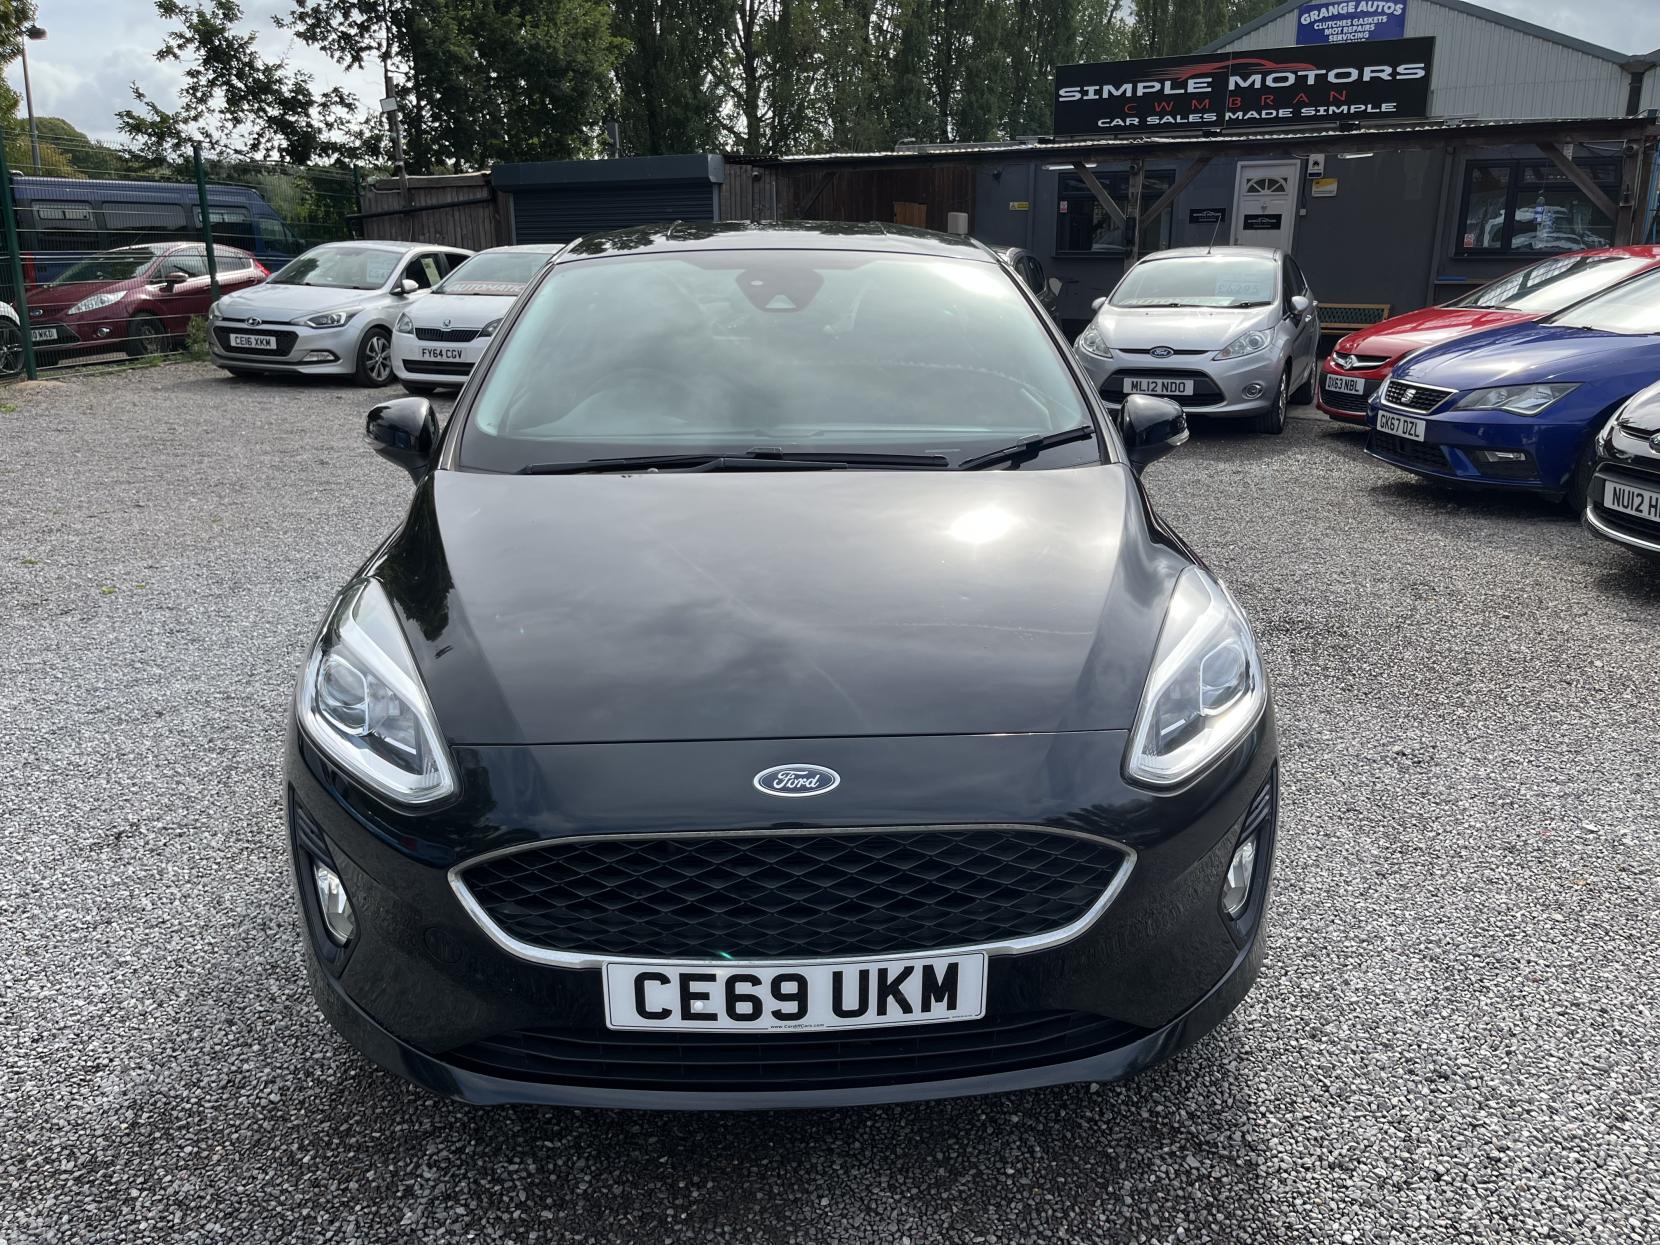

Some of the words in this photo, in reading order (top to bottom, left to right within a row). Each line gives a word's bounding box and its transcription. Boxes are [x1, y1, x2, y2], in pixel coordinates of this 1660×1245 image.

[1300, 1, 1356, 25] GRANGE
[1357, 1, 1404, 15] AUTOS
[1313, 19, 1352, 30] CLUTCHES
[1352, 15, 1388, 26] GASKETS
[1324, 27, 1342, 36] MOT
[1343, 23, 1376, 33] REPAIRS
[1328, 31, 1370, 42] SERVICING
[1058, 77, 1213, 102] SIMPLE
[1228, 63, 1426, 91] MOTORS
[1124, 89, 1347, 114] CWMBRAN
[1097, 117, 1140, 127] CAR
[1146, 112, 1217, 125] SALES
[1225, 108, 1293, 121] MADE
[1300, 102, 1397, 116] SIMPLE
[234, 335, 252, 346] CE16
[254, 336, 272, 348] XKM
[421, 347, 444, 359] FY64
[445, 348, 463, 360] CGV
[1130, 380, 1159, 393] ML12
[1161, 381, 1187, 394] NDO
[1343, 379, 1361, 393] NBL
[1380, 414, 1402, 432] GK67
[1402, 419, 1421, 438] DZL
[1612, 486, 1645, 514] NU12
[1647, 495, 1660, 519] H
[773, 770, 821, 789] Ford
[633, 970, 809, 1022] CE69
[831, 961, 960, 1019] UKM
